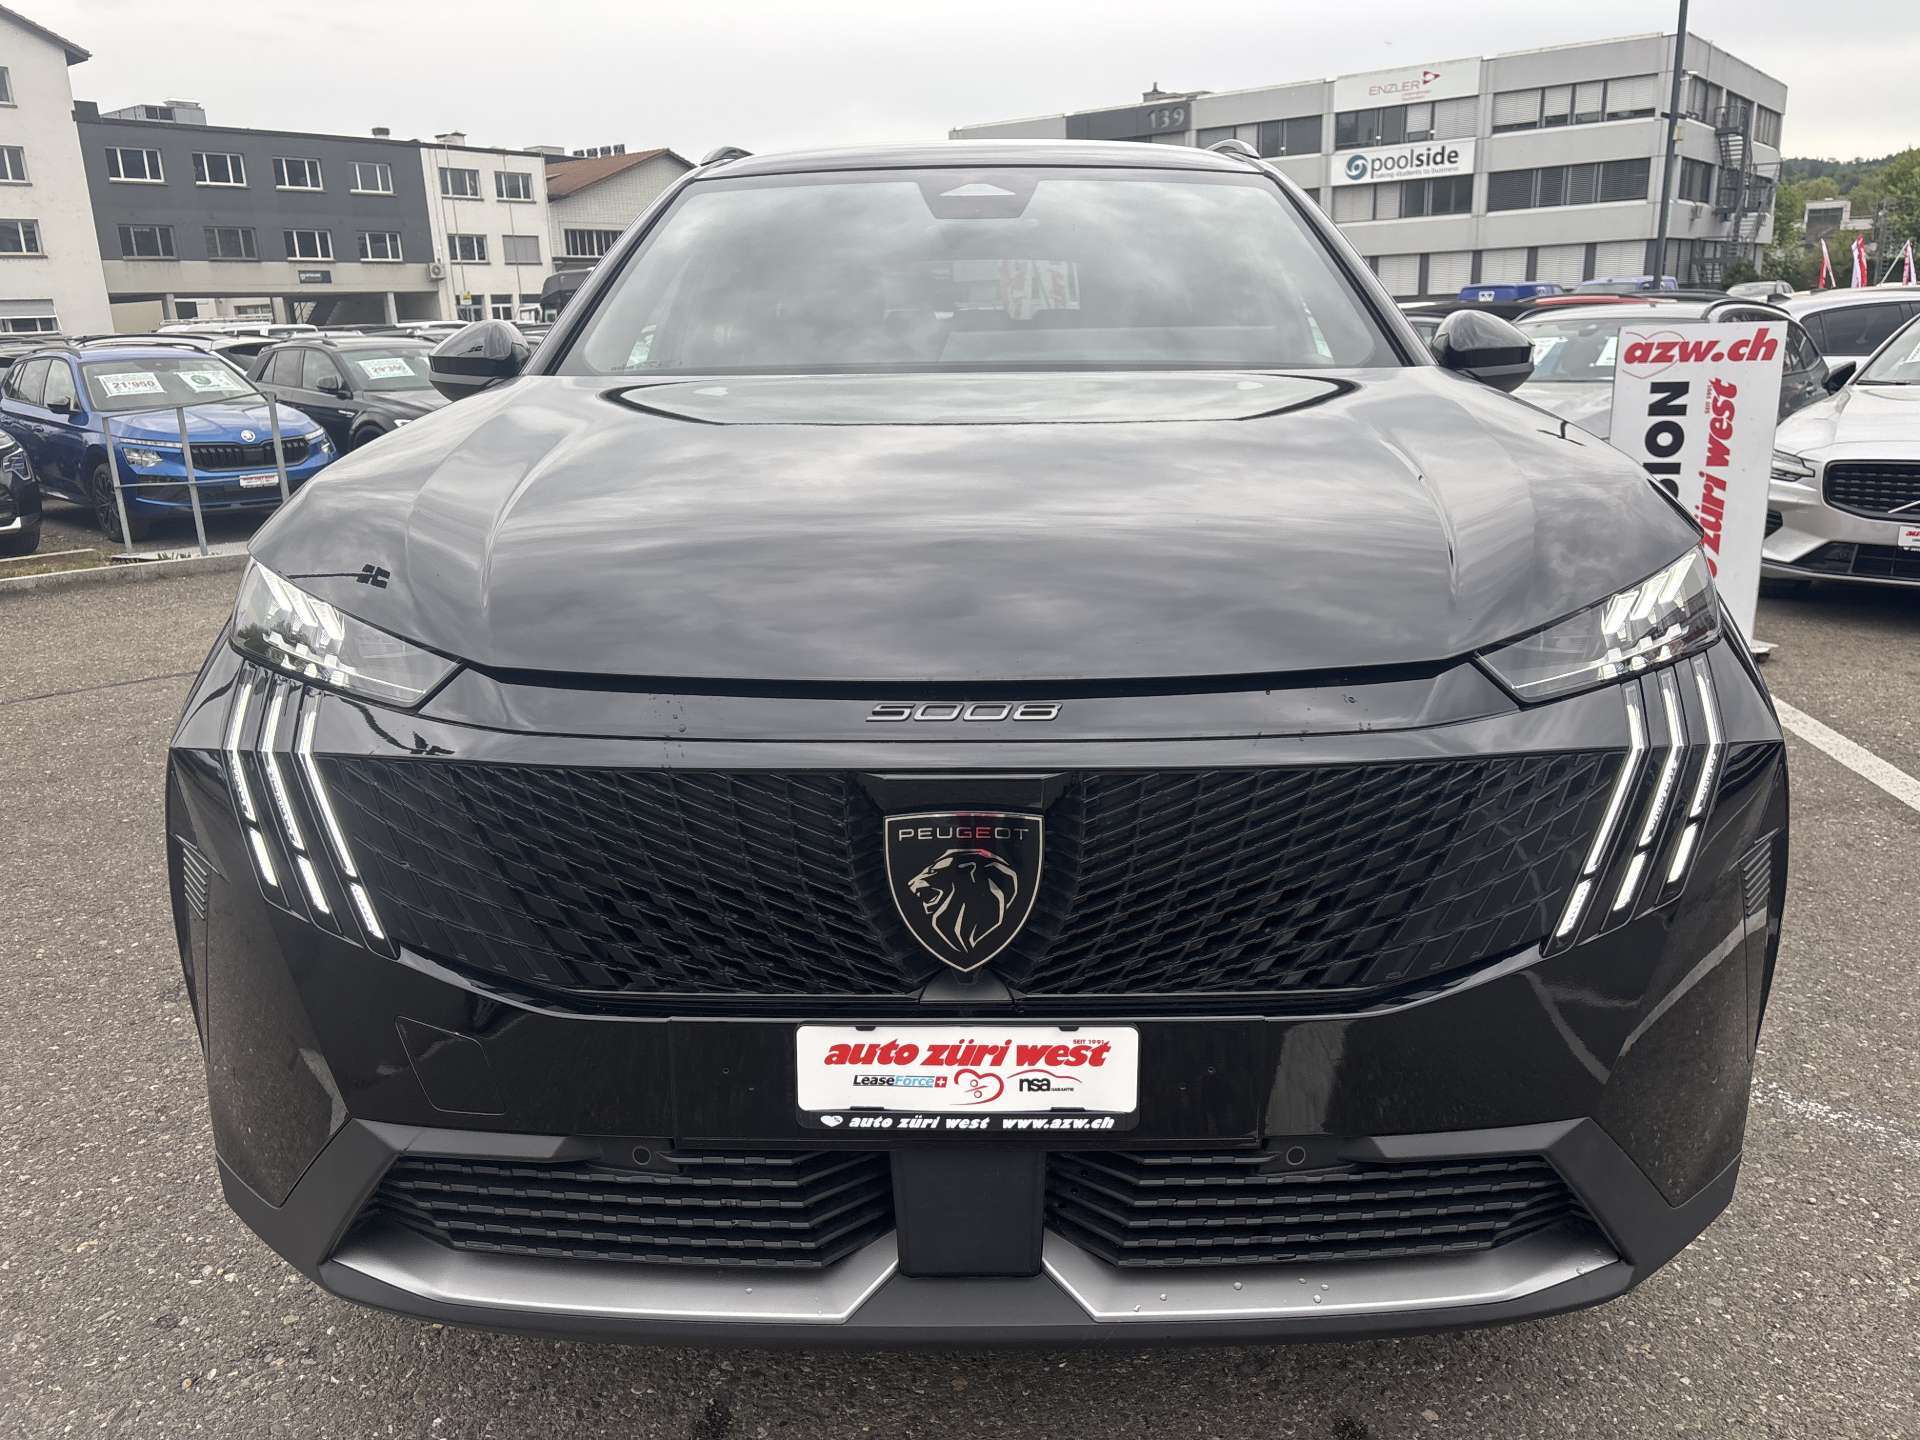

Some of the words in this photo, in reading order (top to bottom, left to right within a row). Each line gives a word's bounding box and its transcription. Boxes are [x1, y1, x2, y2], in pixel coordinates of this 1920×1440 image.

[1369, 80, 1420, 96] ENZLER
[1150, 108, 1184, 128] 139
[1370, 145, 1459, 179] poolside
[1623, 328, 1778, 365] azw.ch
[1704, 377, 1738, 467] west
[864, 702, 1063, 722] 5008
[898, 827, 1029, 842] PEUGEOT
[824, 1039, 919, 1065] auto
[920, 1039, 1012, 1066] züri
[1016, 1041, 1111, 1067] west
[853, 1075, 934, 1087] LeaseForce
[1019, 1078, 1051, 1092] nsa
[849, 1116, 893, 1128] auto
[897, 1115, 940, 1128] züri
[945, 1116, 990, 1129] west
[1002, 1116, 1115, 1129] www.azw.ch
